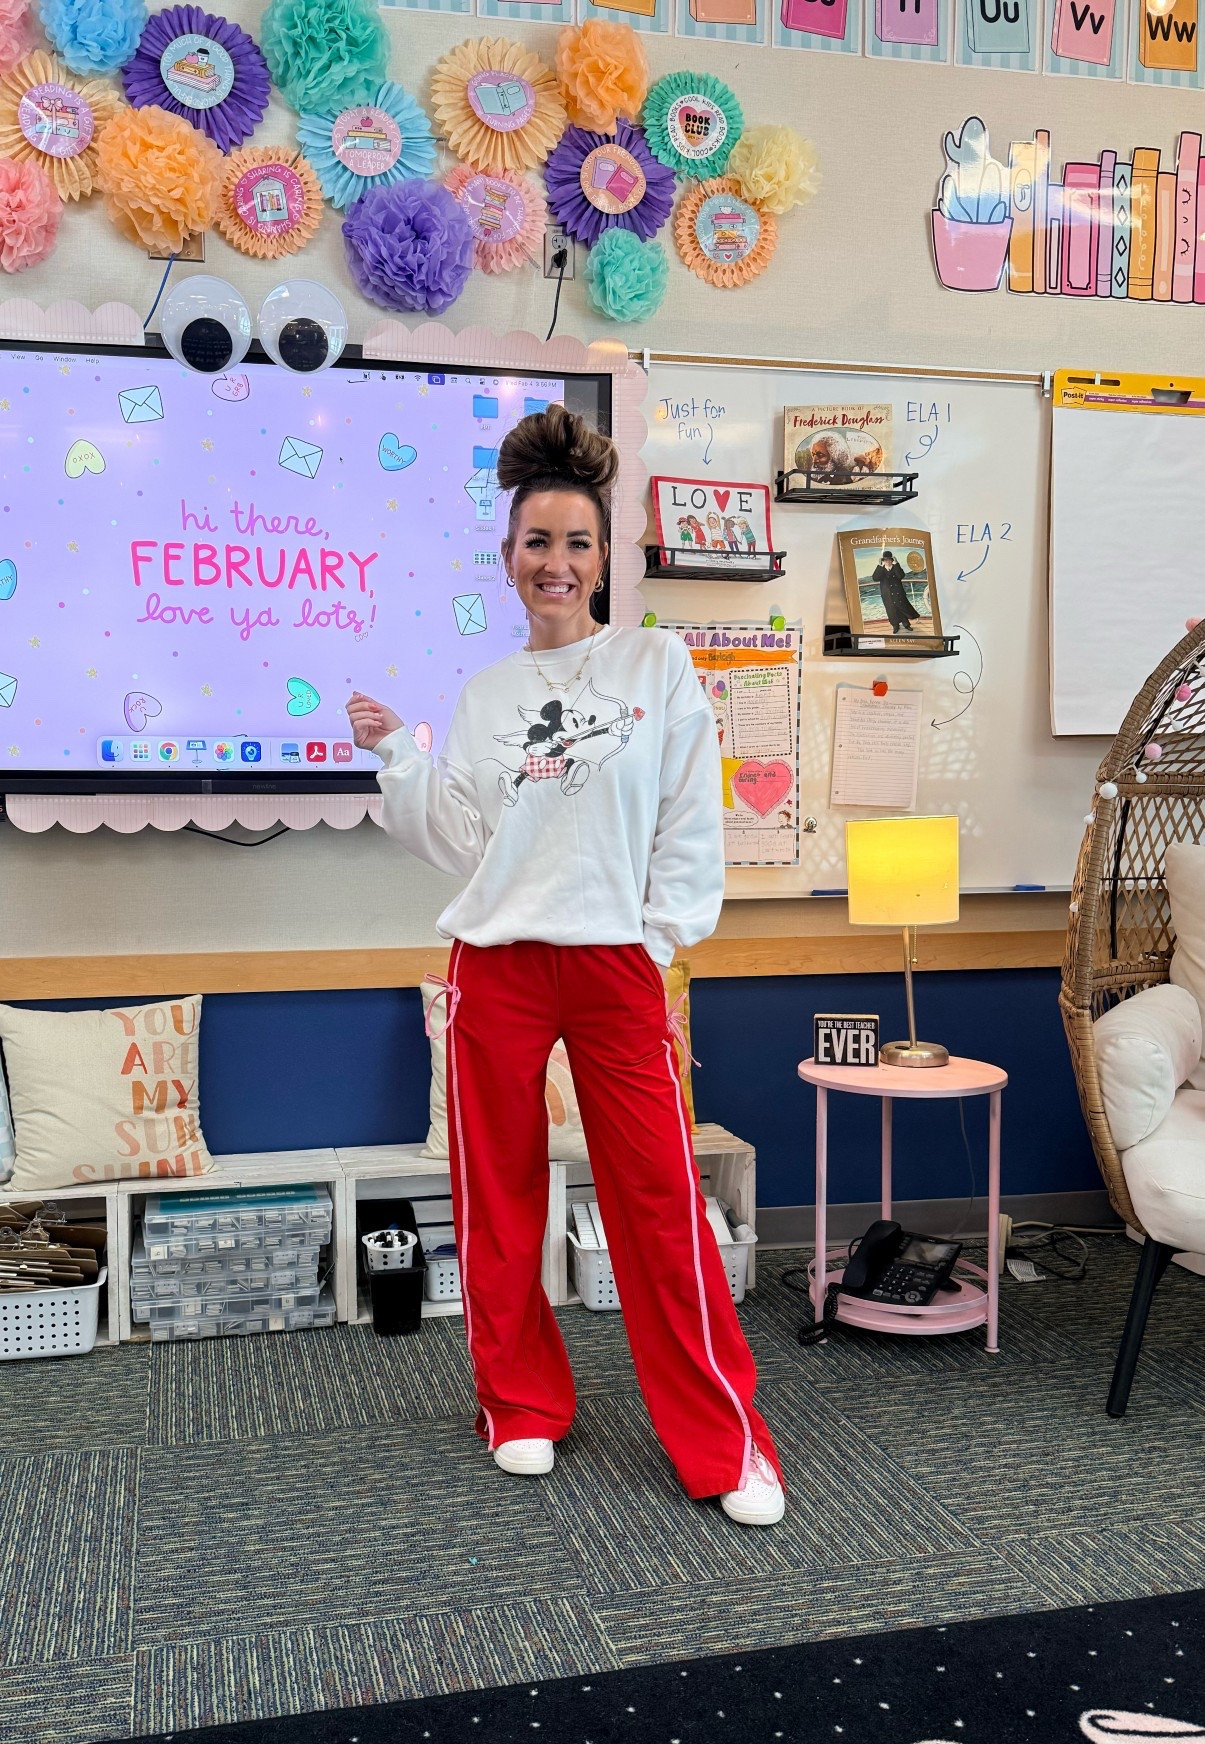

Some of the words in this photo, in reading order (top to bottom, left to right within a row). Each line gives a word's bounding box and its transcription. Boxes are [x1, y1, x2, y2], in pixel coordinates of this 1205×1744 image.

[1070, 1, 1105, 36] Vv
[1147, 12, 1197, 44] Ww
[163, 52, 174, 66] TOO
[170, 37, 192, 52] MUCH
[212, 45, 228, 62] GOOD
[222, 65, 232, 90] THING
[684, 96, 700, 104] COOL
[702, 98, 716, 110] KIDS
[32, 85, 72, 98] READING
[74, 96, 84, 106] IS
[82, 116, 92, 140] GIFT
[338, 108, 358, 125] TODAY
[370, 109, 396, 130] READER
[670, 102, 682, 122] BOOKS
[686, 112, 710, 126] BOOK
[714, 110, 724, 124] READ
[22, 100, 38, 142] READING
[60, 142, 80, 156] GIFT
[684, 122, 710, 136] CLUB
[712, 126, 726, 149] BOOKS
[345, 151, 390, 161] TOMORROW
[596, 146, 612, 156] OUR
[676, 142, 690, 156] KIDS
[692, 148, 708, 156] COOL
[349, 158, 355, 168] A
[358, 160, 385, 170] LEADER
[247, 166, 281, 180] SHARING
[283, 170, 292, 178] IS
[290, 178, 302, 210] CARING
[248, 216, 256, 226] IS
[1064, 391, 1084, 399] Post-it
[659, 398, 700, 419] Just
[906, 401, 940, 422] ELA
[947, 402, 951, 422] 1
[794, 412, 839, 428] Frederick
[841, 411, 885, 430] Douglass
[678, 422, 702, 440] fun
[382, 444, 406, 464] WORTHY
[181, 498, 218, 532] hi
[230, 500, 330, 540] there,
[850, 534, 900, 546] Grandfather's
[902, 536, 925, 547] Journey
[956, 522, 992, 544] ELA
[1000, 522, 1013, 542] 2
[130, 540, 378, 598] FEBRUARY,
[136, 592, 214, 624] love
[230, 606, 280, 642] ya
[293, 598, 376, 634] lots!
[684, 632, 706, 648] All
[709, 632, 758, 648] About
[760, 633, 792, 648] Me!
[128, 698, 146, 712] ROCK
[336, 748, 350, 756] Aa
[110, 1003, 196, 1036] YOU
[856, 1022, 876, 1030] TEACHER
[818, 1028, 876, 1064] EVER
[120, 1042, 196, 1074] ARE
[132, 1079, 196, 1114] MY
[114, 1114, 199, 1156] SUN
